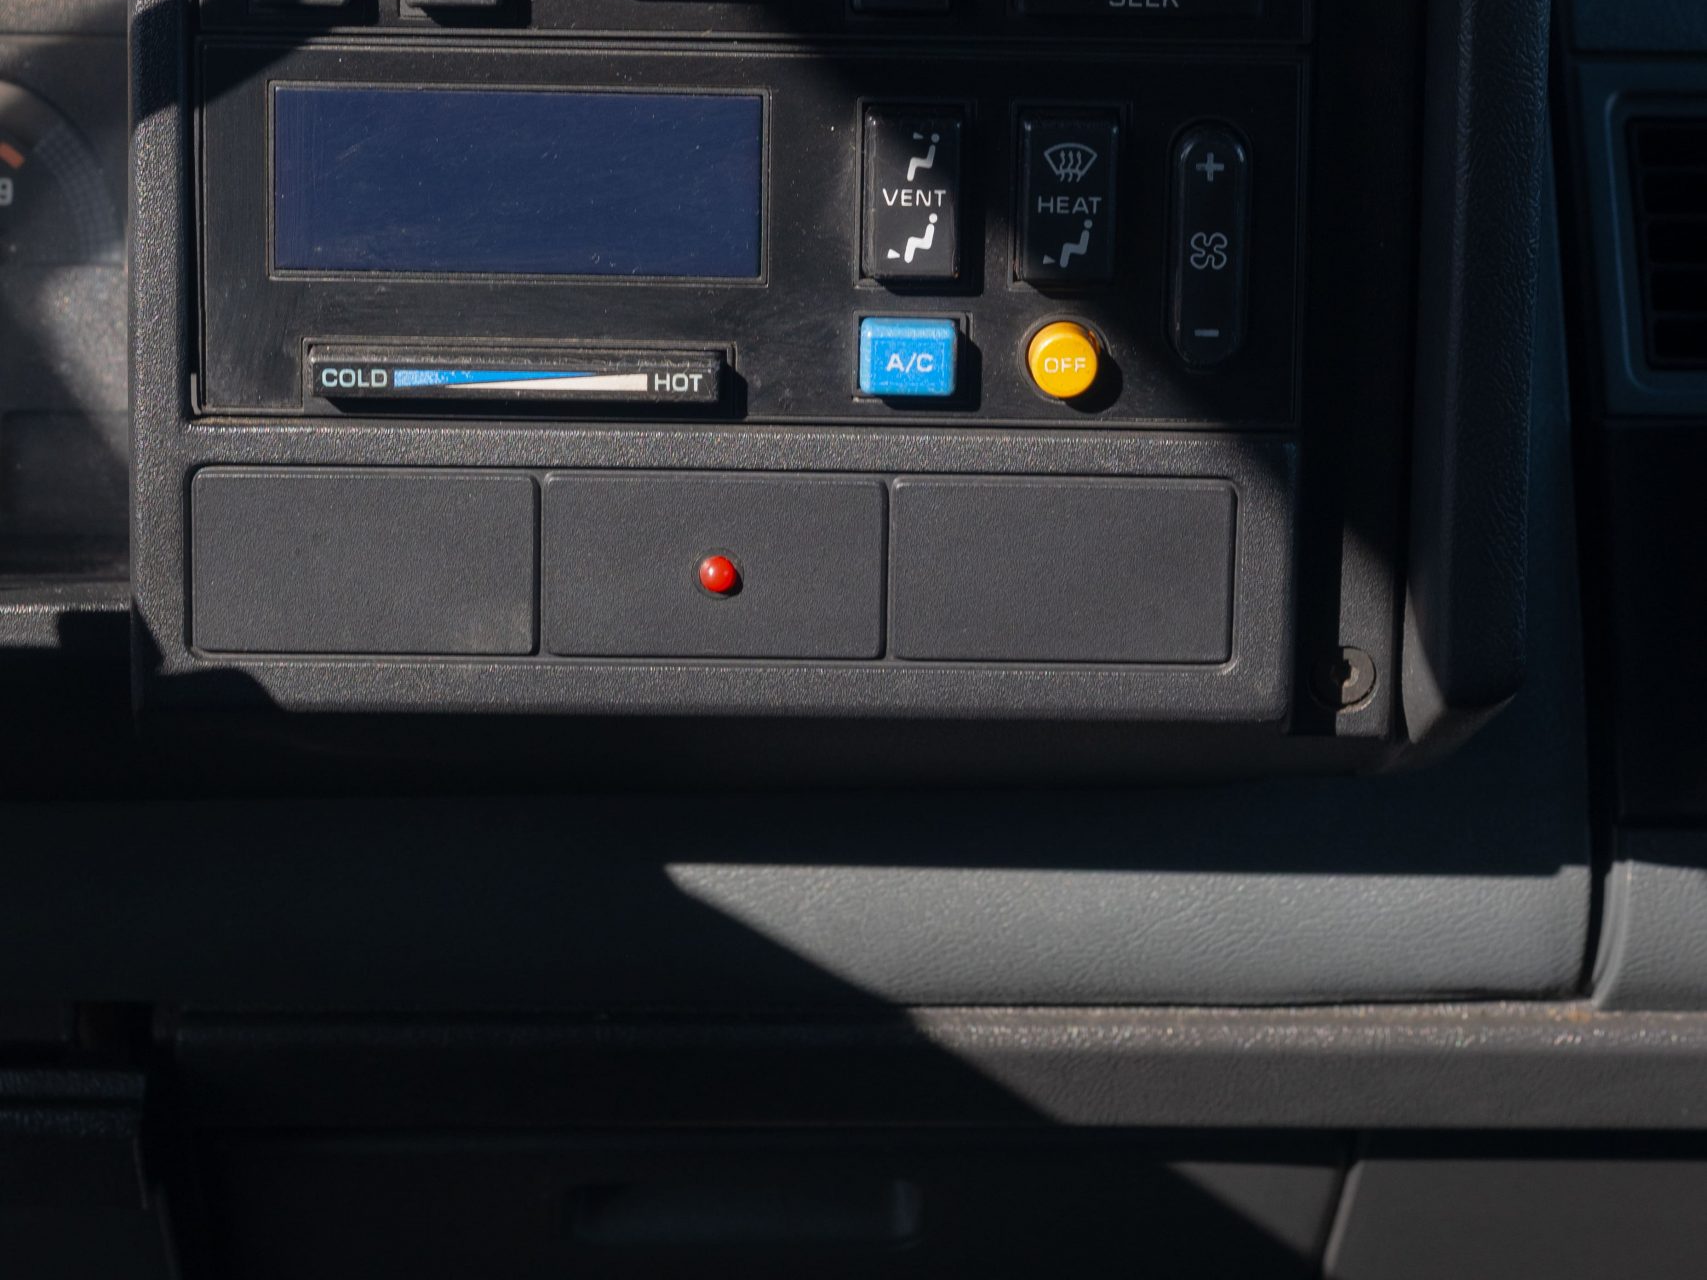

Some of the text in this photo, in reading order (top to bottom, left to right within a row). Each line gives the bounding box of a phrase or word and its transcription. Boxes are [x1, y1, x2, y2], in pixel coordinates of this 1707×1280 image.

[883, 188, 946, 208] VENT
[1038, 194, 1101, 214] HEAT
[886, 353, 933, 373] A/C
[1044, 356, 1086, 375] OFF
[321, 368, 704, 393] COLD HOT
